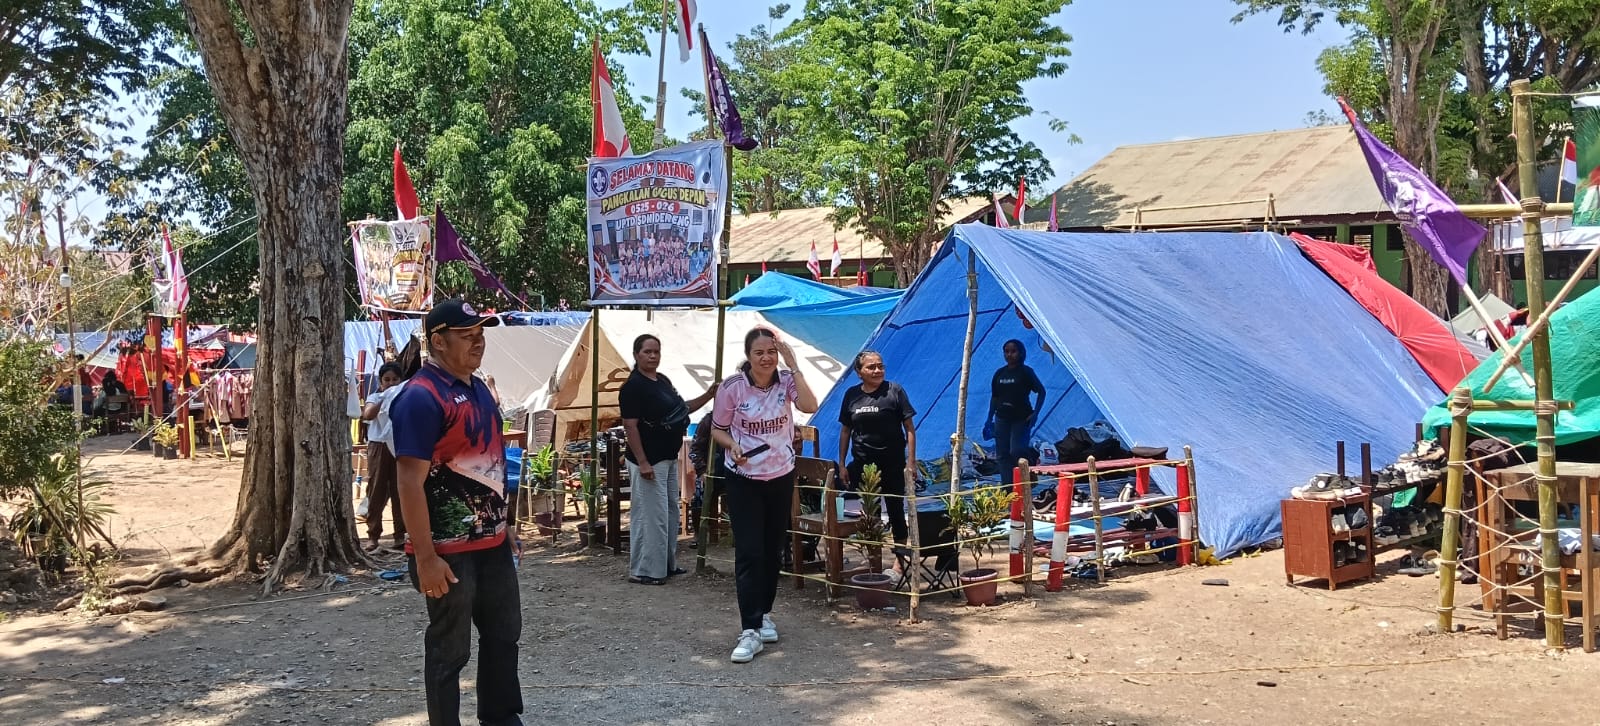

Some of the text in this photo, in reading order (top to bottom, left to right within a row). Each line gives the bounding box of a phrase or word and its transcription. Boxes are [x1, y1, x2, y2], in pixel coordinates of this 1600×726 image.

[610, 160, 696, 190] SELAMAT DATANG
[602, 187, 650, 212] PANGKALAN
[679, 188, 706, 206] DEPAN
[630, 202, 649, 214] 0525
[616, 216, 636, 231] UPTD
[741, 414, 789, 429] Emirates
